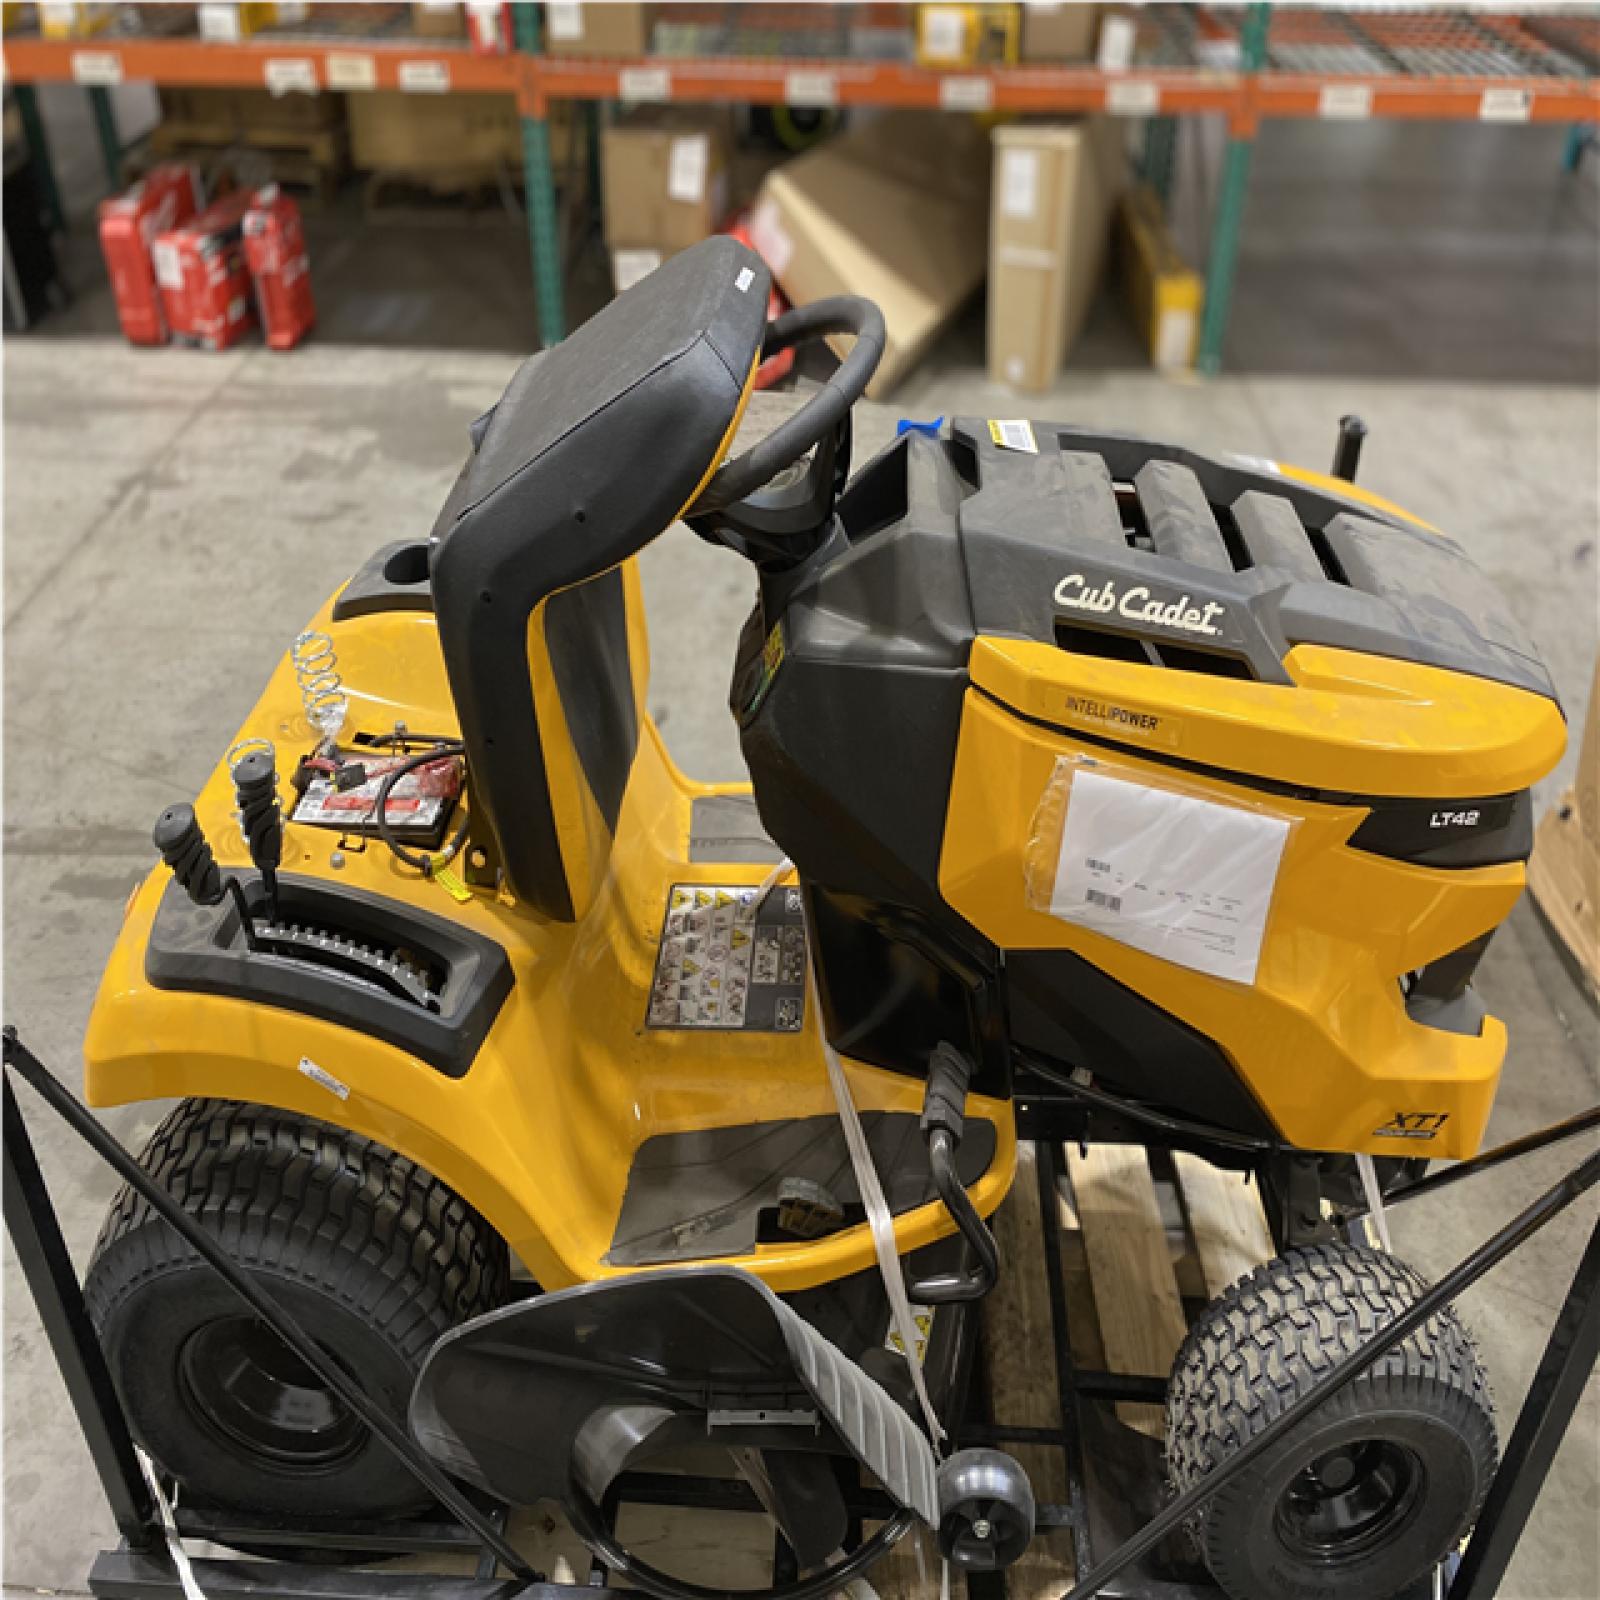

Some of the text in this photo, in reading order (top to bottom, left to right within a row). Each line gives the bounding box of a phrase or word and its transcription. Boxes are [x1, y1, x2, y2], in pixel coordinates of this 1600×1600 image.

[1054, 574, 1225, 635] Cub Cadet
[1065, 695, 1159, 730] INTELLIPOWER
